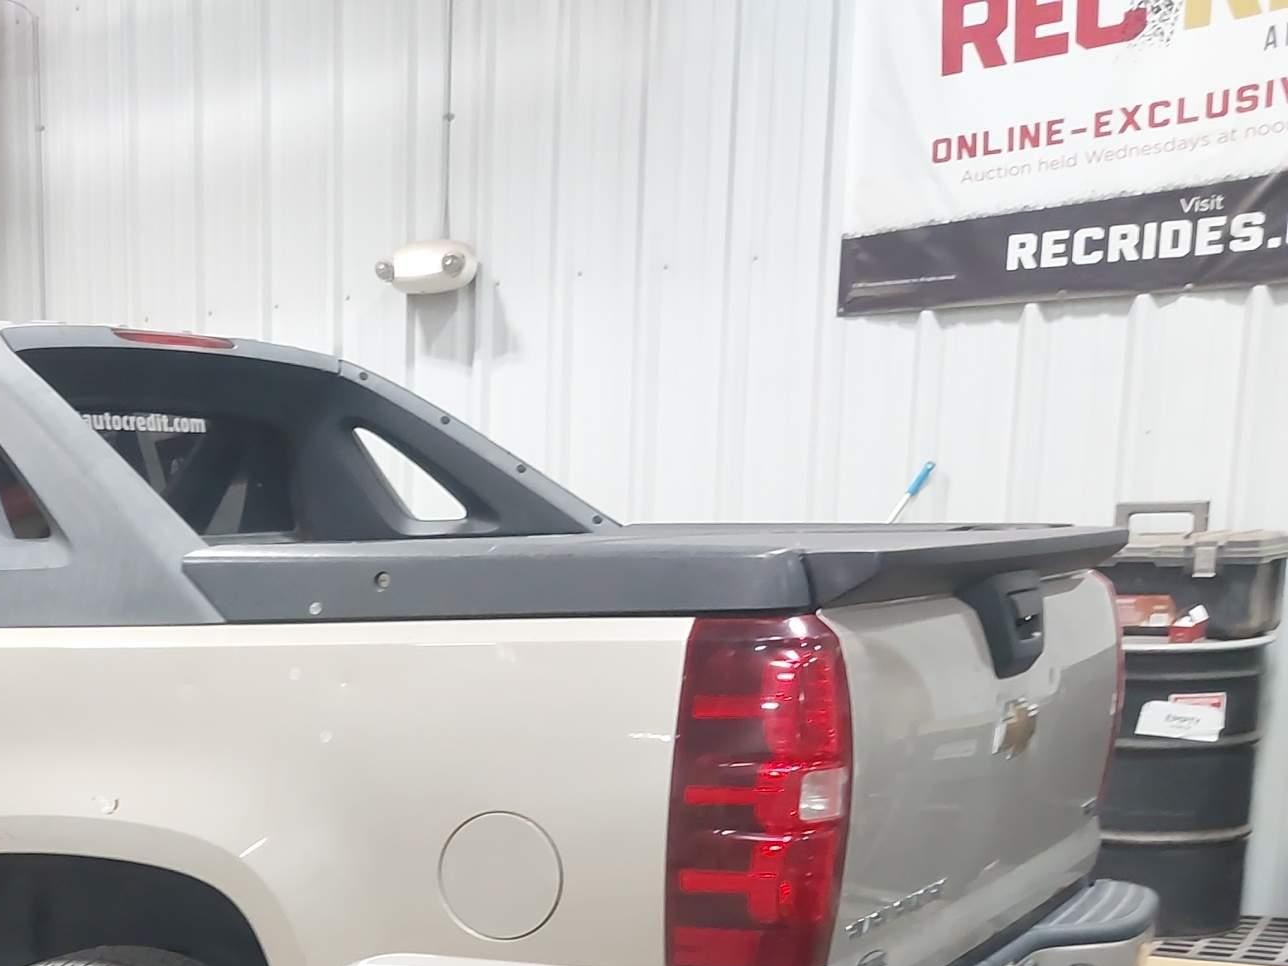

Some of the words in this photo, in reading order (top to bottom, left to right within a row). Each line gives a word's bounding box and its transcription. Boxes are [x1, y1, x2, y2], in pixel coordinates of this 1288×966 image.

[961, 163, 1032, 184] Auction
[1039, 152, 1078, 172] held
[1085, 134, 1210, 164] Wednesdays
[1216, 129, 1237, 144] at
[1245, 120, 1288, 138] noo
[1179, 194, 1225, 213] Visit
[1006, 211, 1288, 271] RECRIDES.
